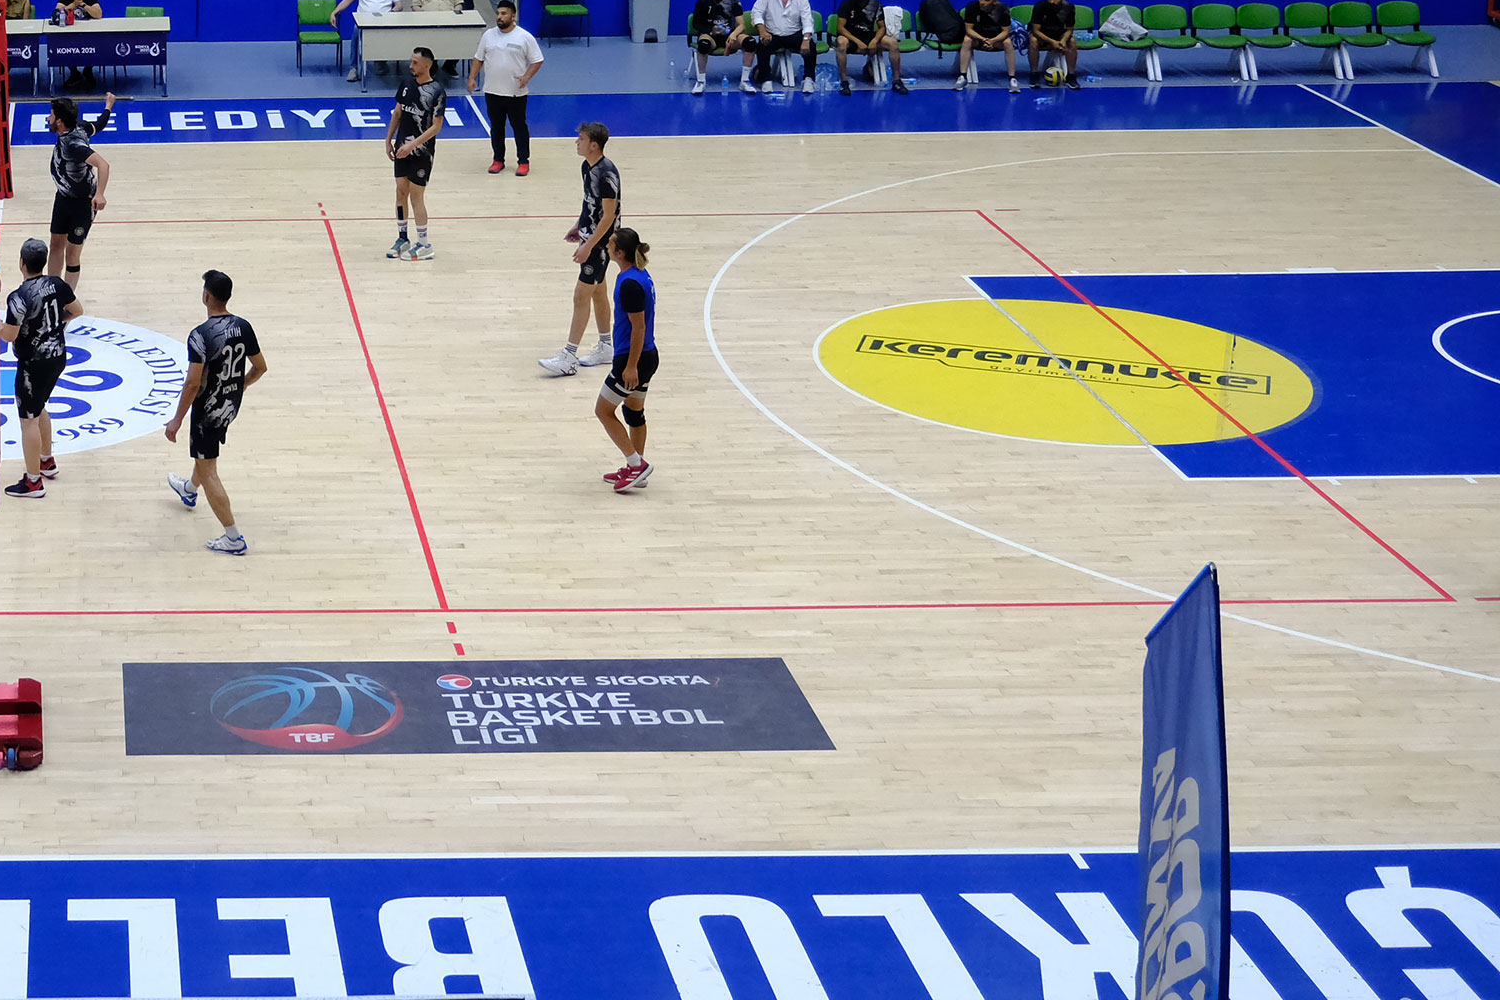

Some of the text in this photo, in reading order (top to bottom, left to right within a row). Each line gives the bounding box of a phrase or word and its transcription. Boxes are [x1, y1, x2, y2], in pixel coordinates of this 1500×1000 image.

[43, 298, 60, 333] 11
[54, 417, 125, 441] 989
[441, 690, 637, 709] TÜRKİYE
[446, 708, 726, 727] BASKETBOL
[287, 732, 336, 744] TBF
[452, 726, 539, 745] LİGİ
